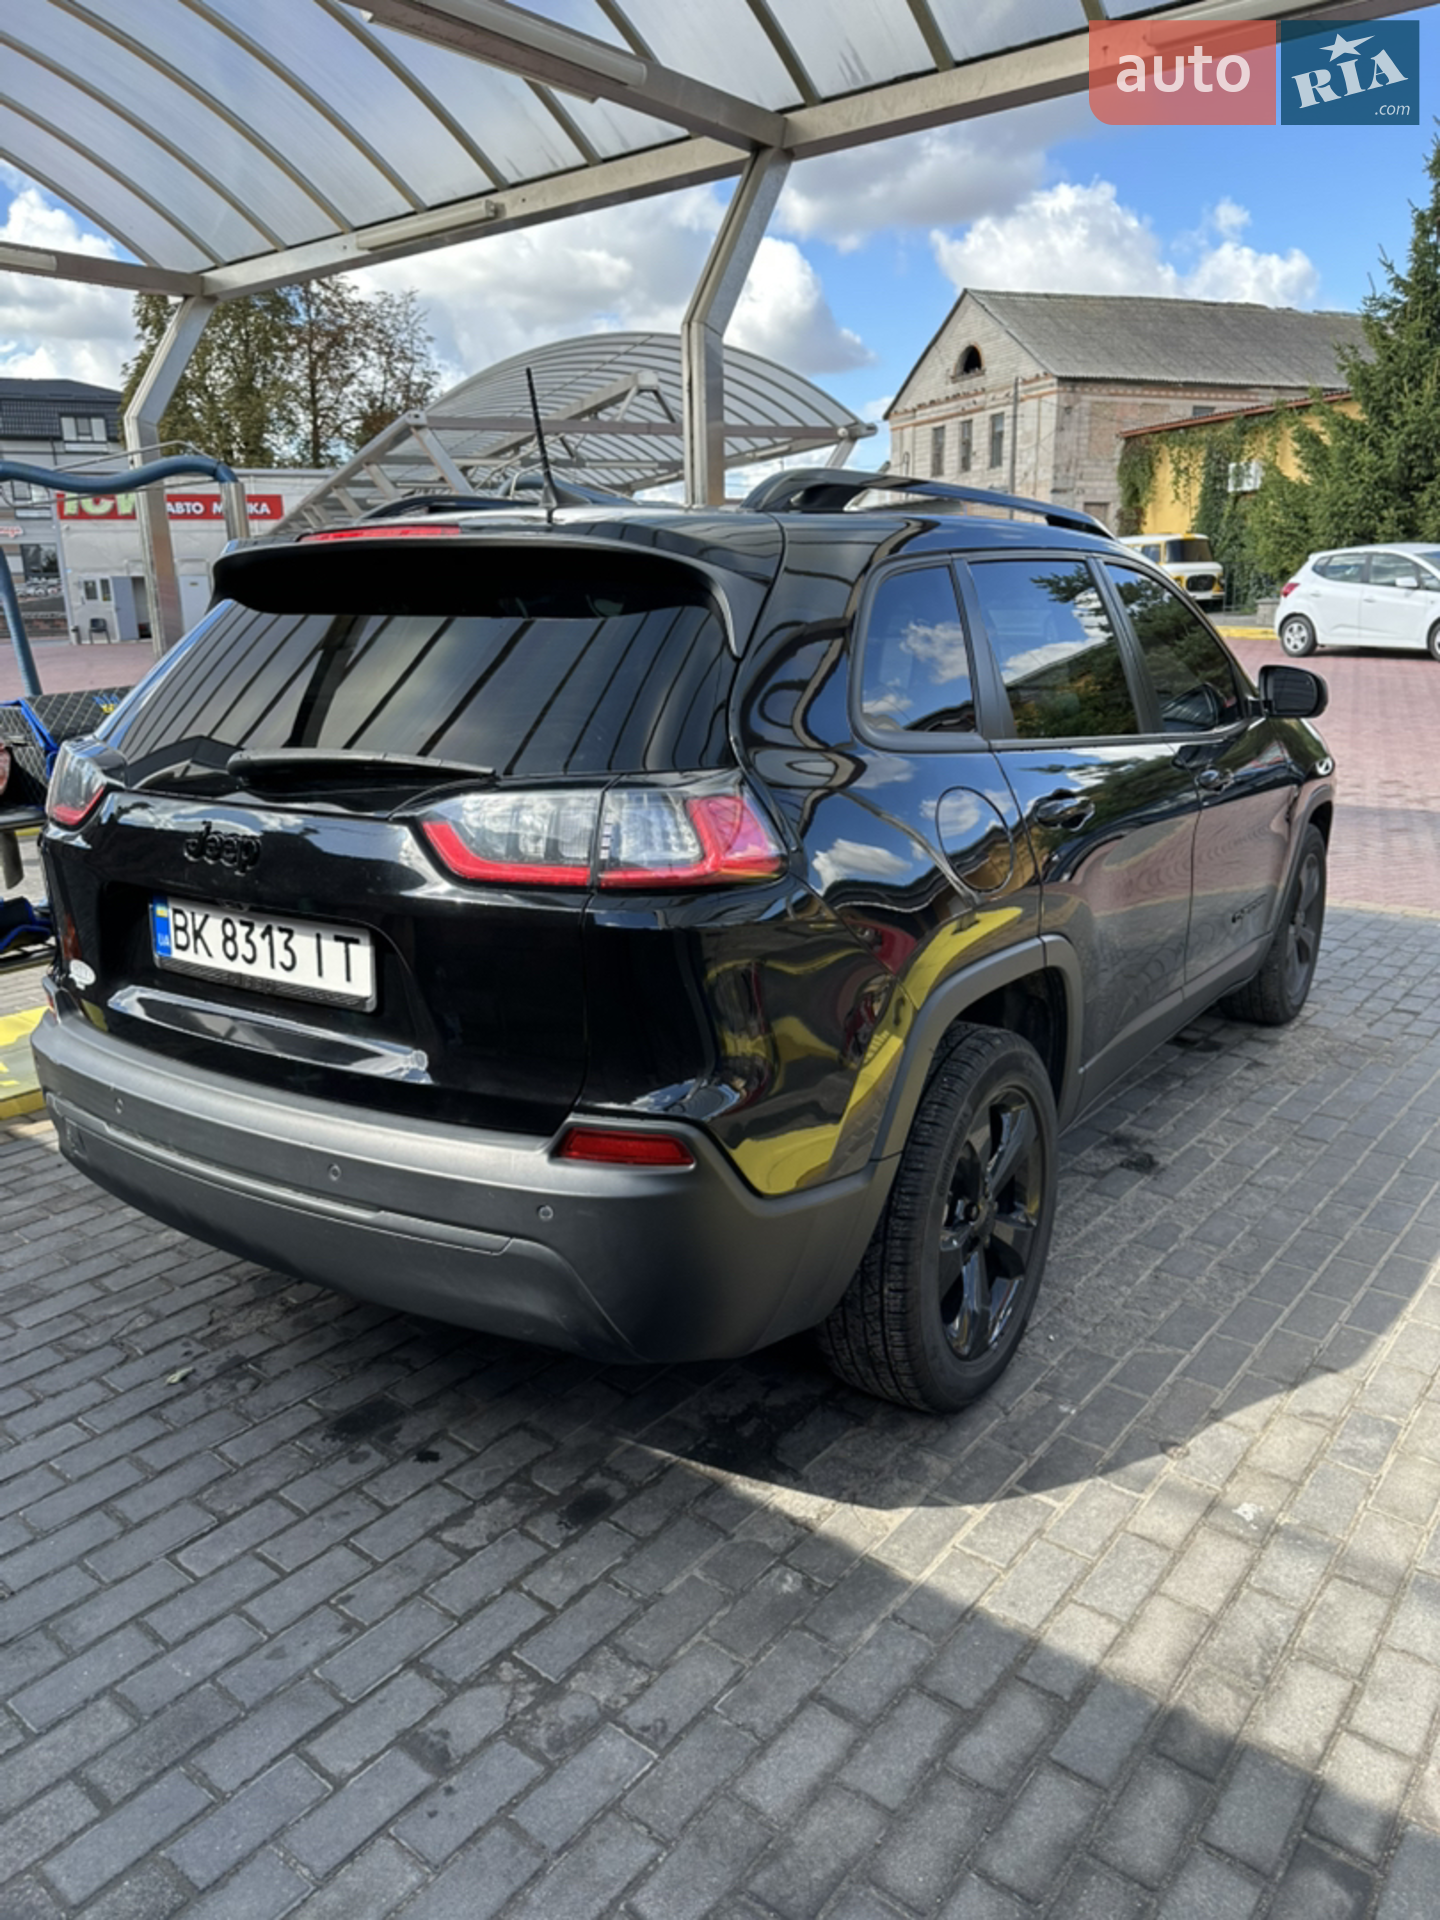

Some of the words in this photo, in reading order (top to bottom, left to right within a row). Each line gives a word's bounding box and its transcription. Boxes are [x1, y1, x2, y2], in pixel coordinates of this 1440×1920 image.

[166, 501, 205, 515] АВТО
[212, 501, 272, 515] МКА
[172, 908, 213, 958] BK
[221, 918, 297, 972] 8313
[315, 932, 361, 983] IT
